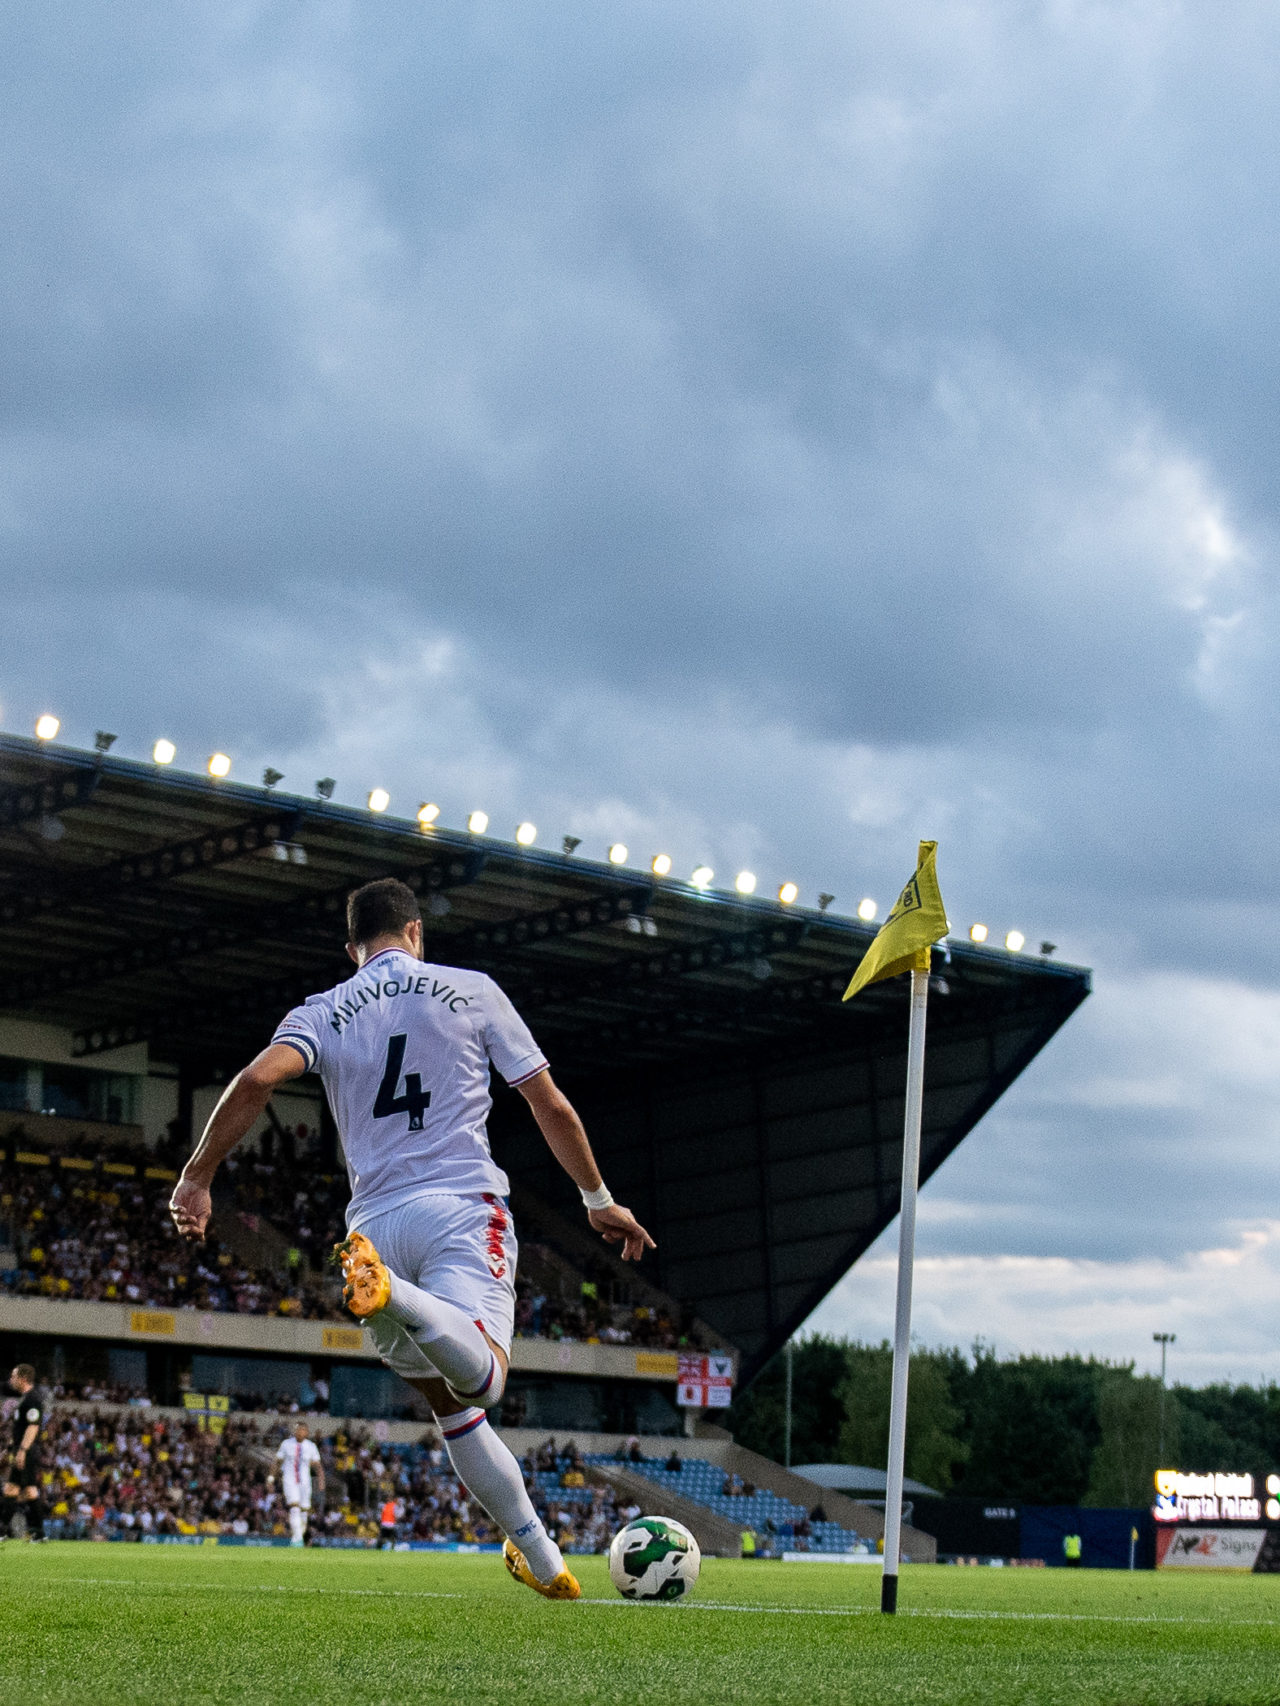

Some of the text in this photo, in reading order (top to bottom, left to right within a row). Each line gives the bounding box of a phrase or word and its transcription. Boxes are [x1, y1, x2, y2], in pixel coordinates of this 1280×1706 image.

[330, 975, 474, 1036] MILIVOJEVIĆ
[373, 1032, 432, 1132] 4
[515, 1520, 537, 1537] CPFC
[1221, 1536, 1257, 1553] Signs
